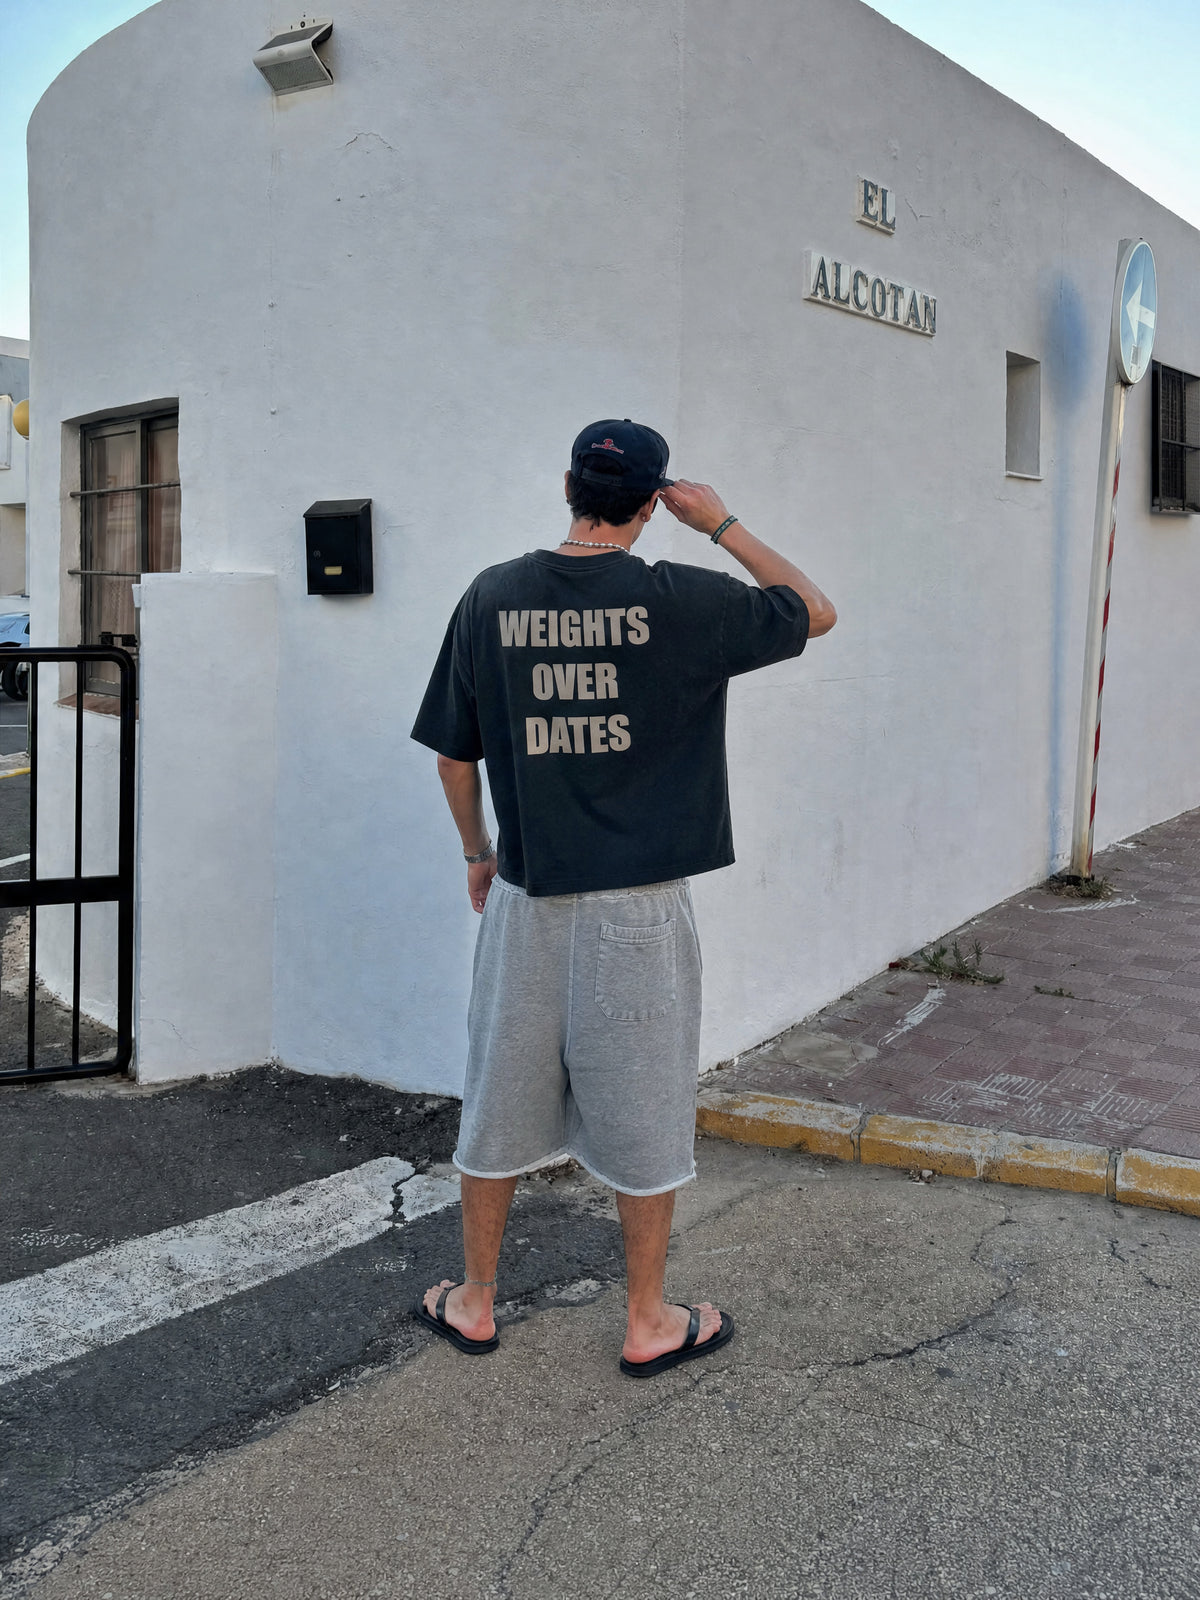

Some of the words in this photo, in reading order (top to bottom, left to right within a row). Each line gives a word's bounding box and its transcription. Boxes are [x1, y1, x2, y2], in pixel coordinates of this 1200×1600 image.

[861, 179, 896, 231] EL
[810, 256, 937, 333] ALCOTAN
[498, 605, 650, 648] WEIGHTS
[532, 662, 619, 700] OVER
[525, 713, 632, 755] DATES
